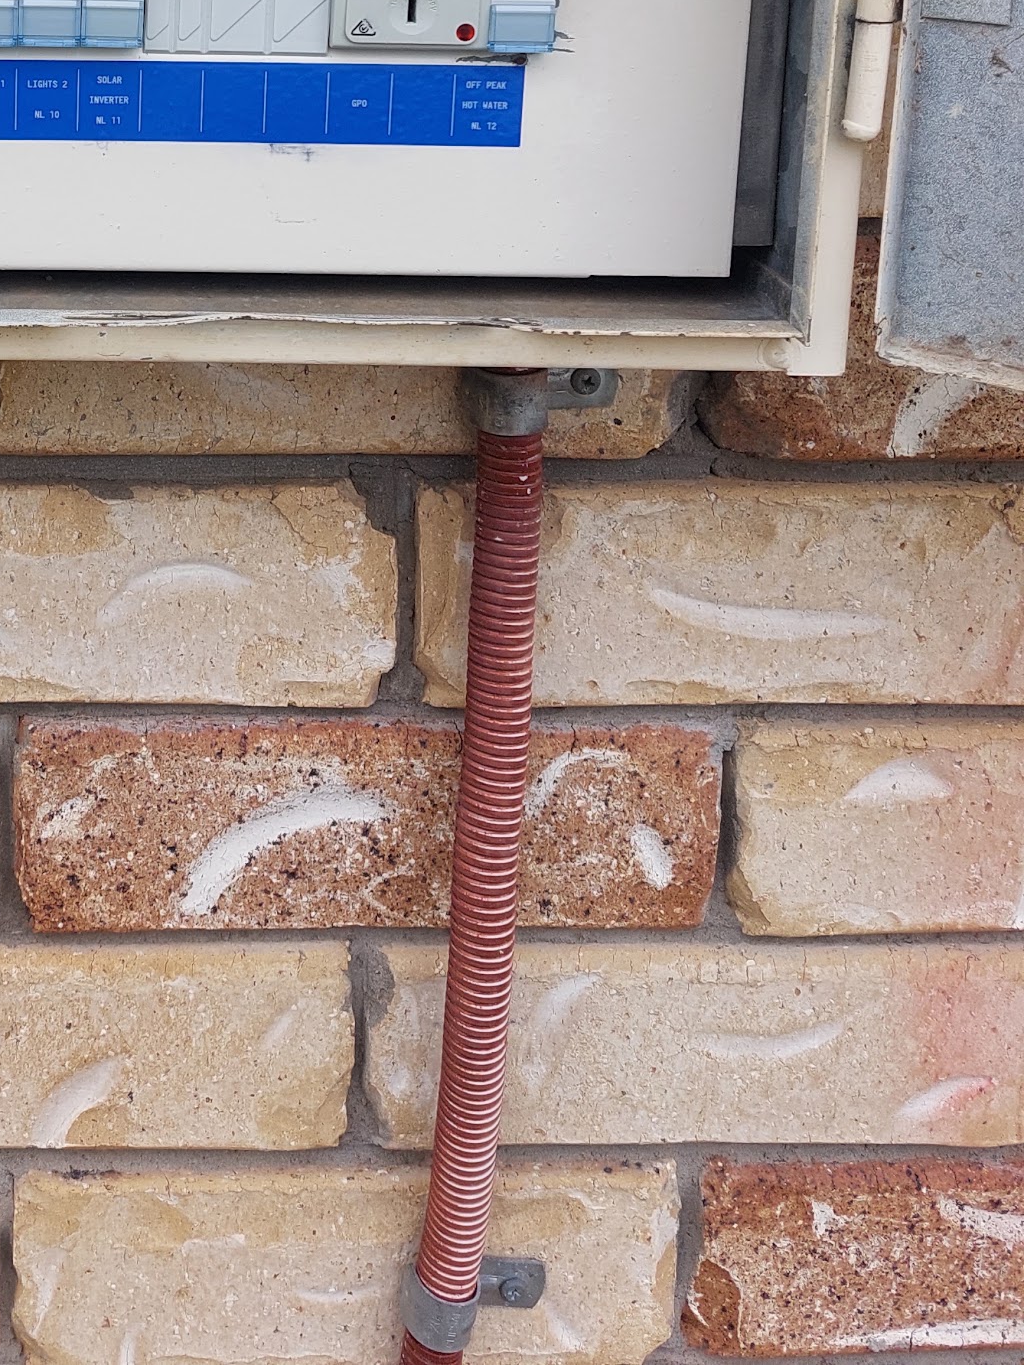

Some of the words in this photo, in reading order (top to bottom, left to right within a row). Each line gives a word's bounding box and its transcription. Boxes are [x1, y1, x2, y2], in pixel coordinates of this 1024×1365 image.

[0, 79, 5, 88] 1
[27, 80, 58, 89] LIGHTS
[62, 80, 68, 89] 2
[96, 76, 123, 84] SOLAR
[466, 81, 483, 90] OFF
[486, 81, 507, 90] PEAK
[89, 96, 129, 105] INVERTER
[351, 99, 368, 108] GPO
[462, 101, 479, 110] HOT
[483, 101, 508, 110] WATER
[34, 110, 45, 119] NL
[49, 110, 60, 119] 10
[95, 116, 107, 125] NL
[111, 116, 121, 125] 11
[471, 122, 482, 131] NL
